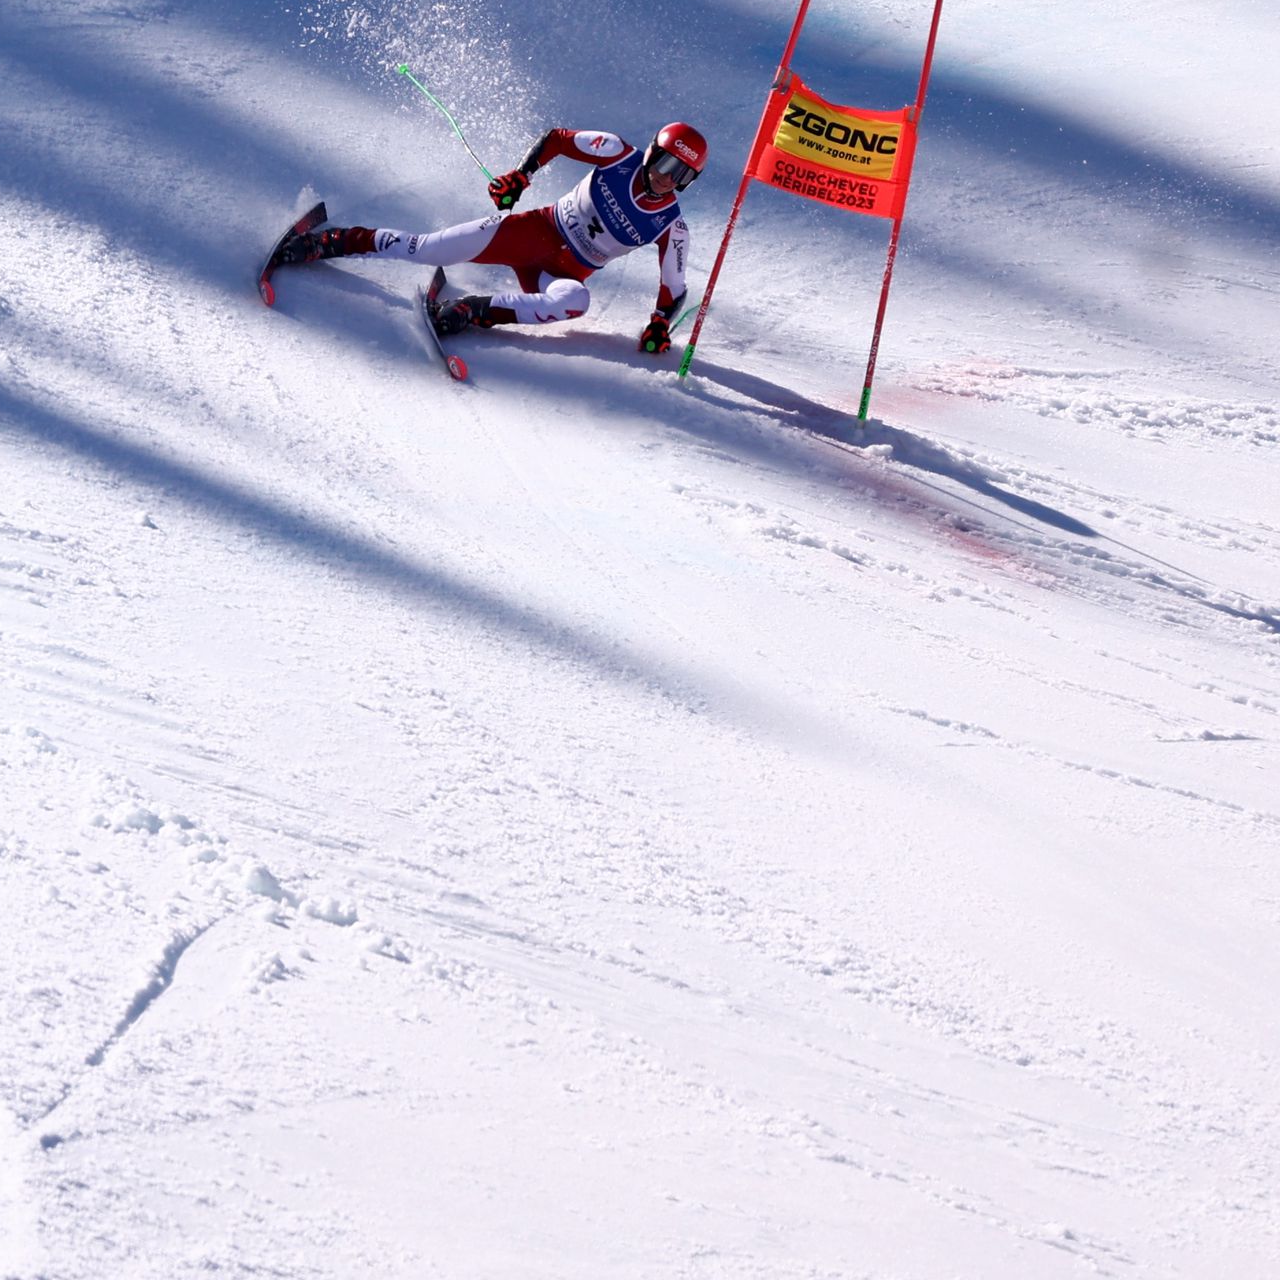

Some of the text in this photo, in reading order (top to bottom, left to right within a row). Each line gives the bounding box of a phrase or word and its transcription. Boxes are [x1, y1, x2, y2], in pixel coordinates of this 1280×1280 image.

[784, 103, 898, 155] ZGONC
[798, 136, 872, 165] www.zgonc.at
[775, 160, 878, 197] COURCHEVEL
[563, 199, 579, 231] SKI
[597, 175, 645, 245] VREDESTEIN
[836, 193, 876, 210] 2023
